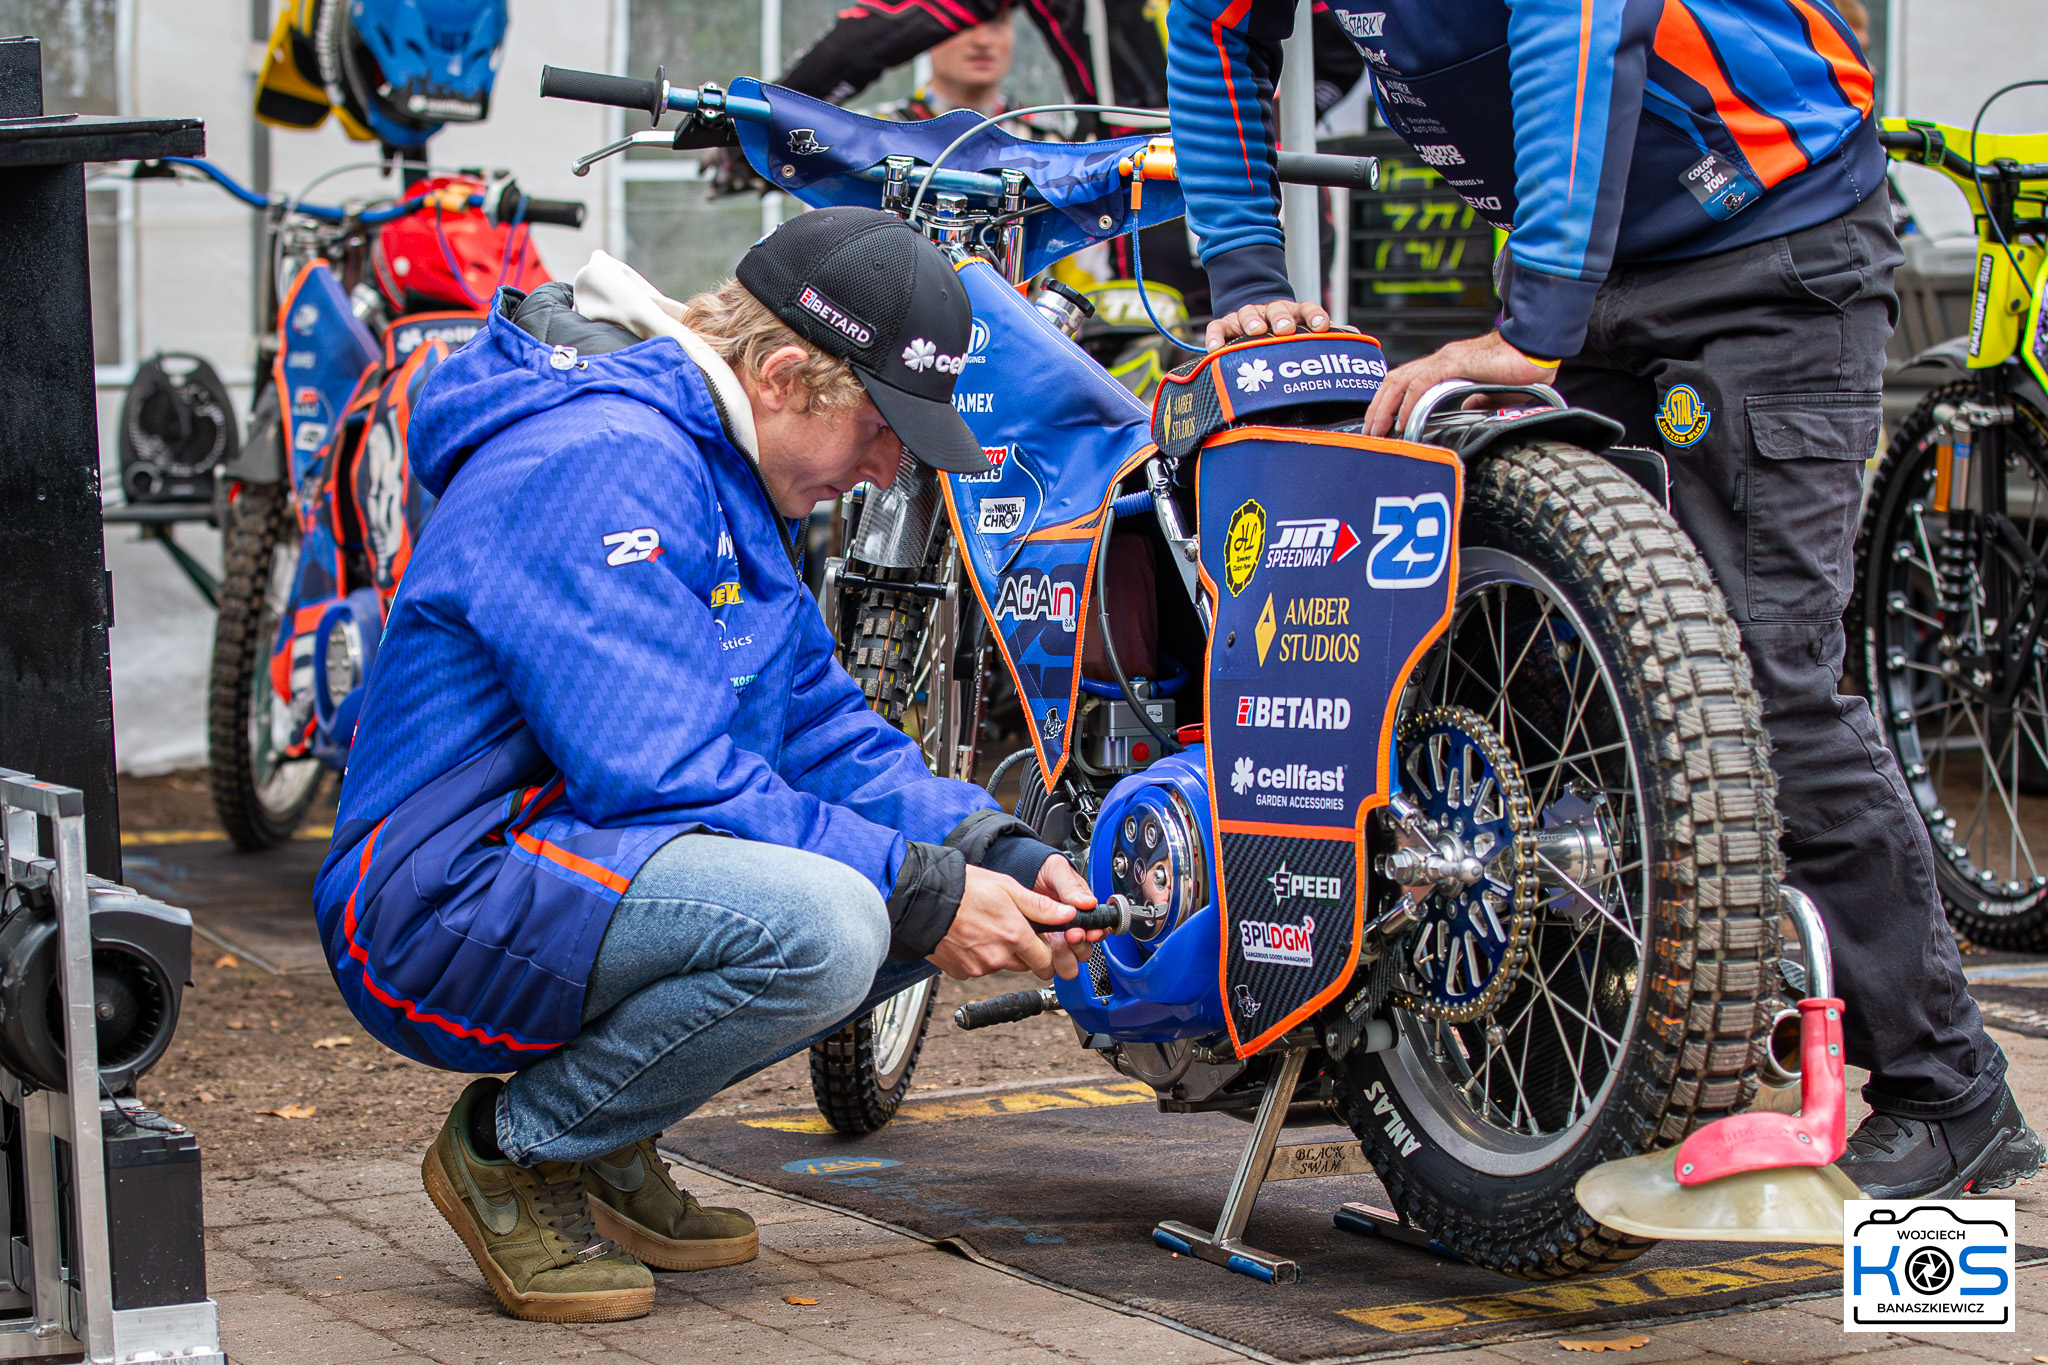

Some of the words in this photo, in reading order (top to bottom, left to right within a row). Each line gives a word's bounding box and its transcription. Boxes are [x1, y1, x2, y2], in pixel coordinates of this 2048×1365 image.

[1420, 144, 1459, 156] MOTO
[1687, 155, 1717, 181] COLOR
[1701, 167, 1714, 183] BY
[1703, 172, 1728, 194] YOU.
[810, 297, 871, 344] BETARD
[1283, 379, 1332, 394] GARDEN
[1173, 392, 1193, 416] AMBER
[1171, 416, 1196, 441] STUDIOS
[994, 503, 1018, 513] NIKKEL
[1265, 548, 1333, 569] SPEEDWAY
[1284, 597, 1350, 627] AMBER
[1279, 633, 1361, 663] STUDIOS
[1254, 696, 1351, 730] BETARD
[1257, 764, 1345, 792] cellfast
[1256, 794, 1288, 807] GARDEN
[1289, 796, 1344, 810] ACCESSORIES
[1273, 872, 1341, 900] SPEED
[1241, 923, 1311, 953] 3PLDGM
[1245, 952, 1269, 960] DANGEROUS
[1268, 953, 1283, 961] GOODS
[1283, 955, 1311, 964] MANAGEMENT
[1363, 1080, 1422, 1158] ANLAS
[1295, 1145, 1346, 1161] BLACK
[1299, 1159, 1342, 1175] SWAN
